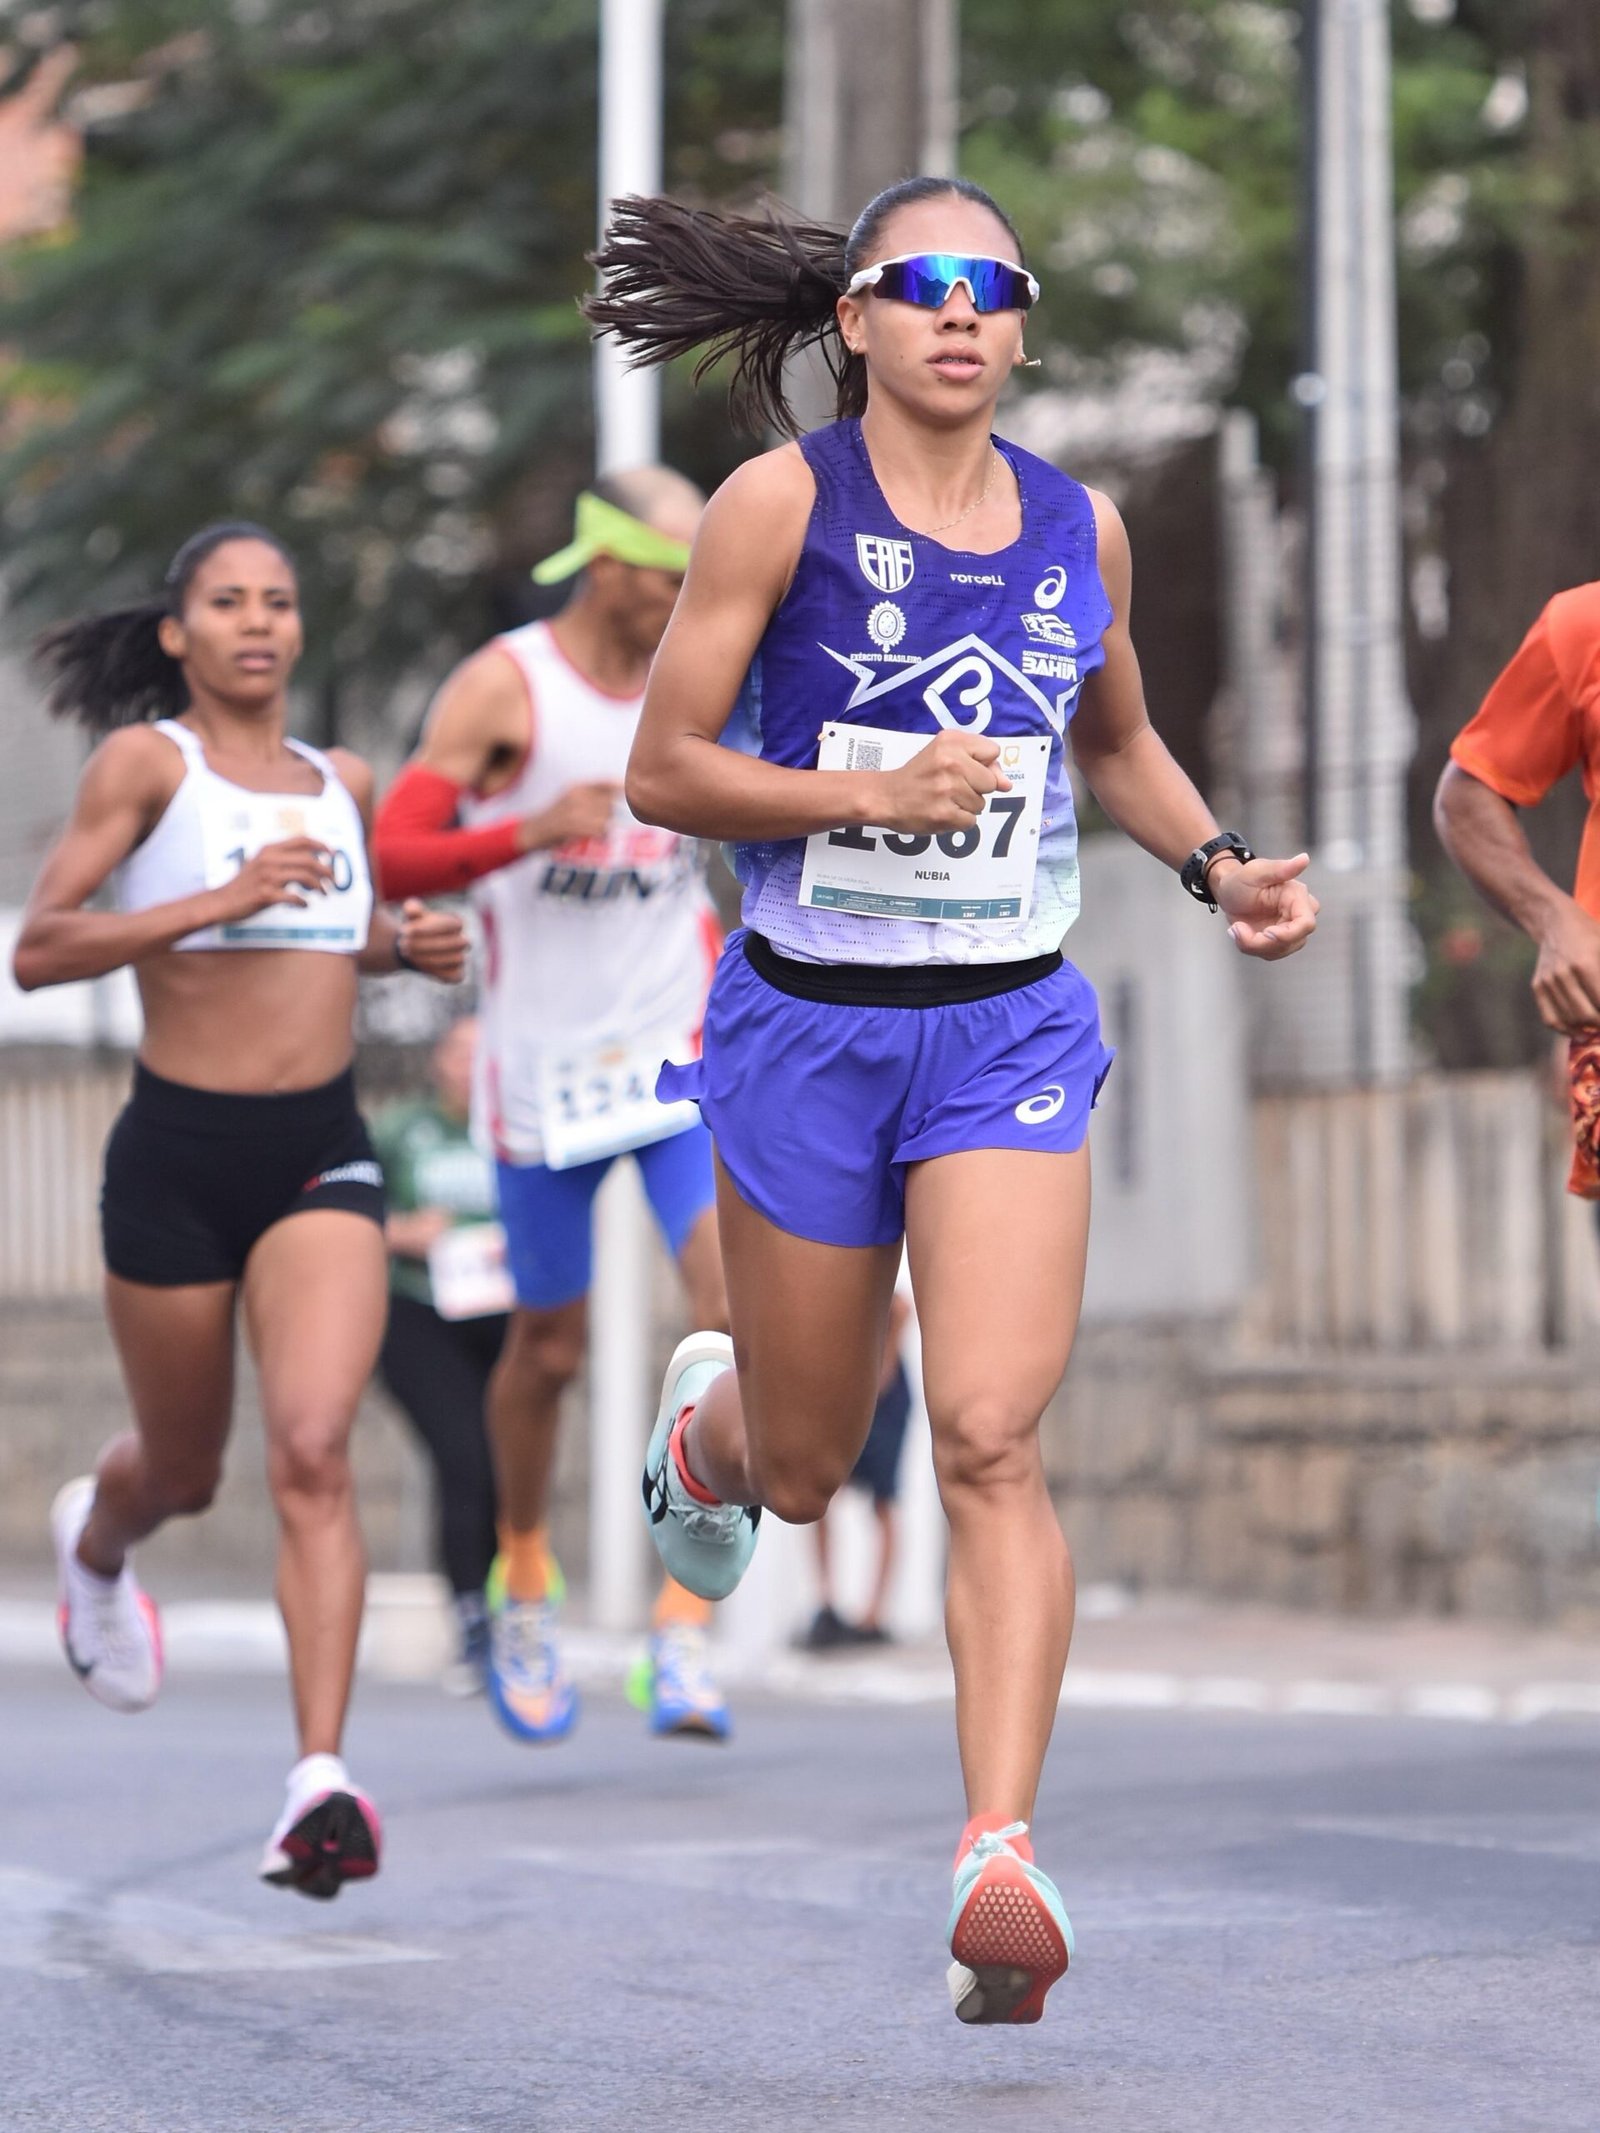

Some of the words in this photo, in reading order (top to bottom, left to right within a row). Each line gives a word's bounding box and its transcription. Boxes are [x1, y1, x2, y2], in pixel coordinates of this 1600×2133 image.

[850, 651, 882, 662] EXÉRCITO
[883, 653, 922, 664] BRASILEIRO
[914, 870, 951, 882] NUBIA
